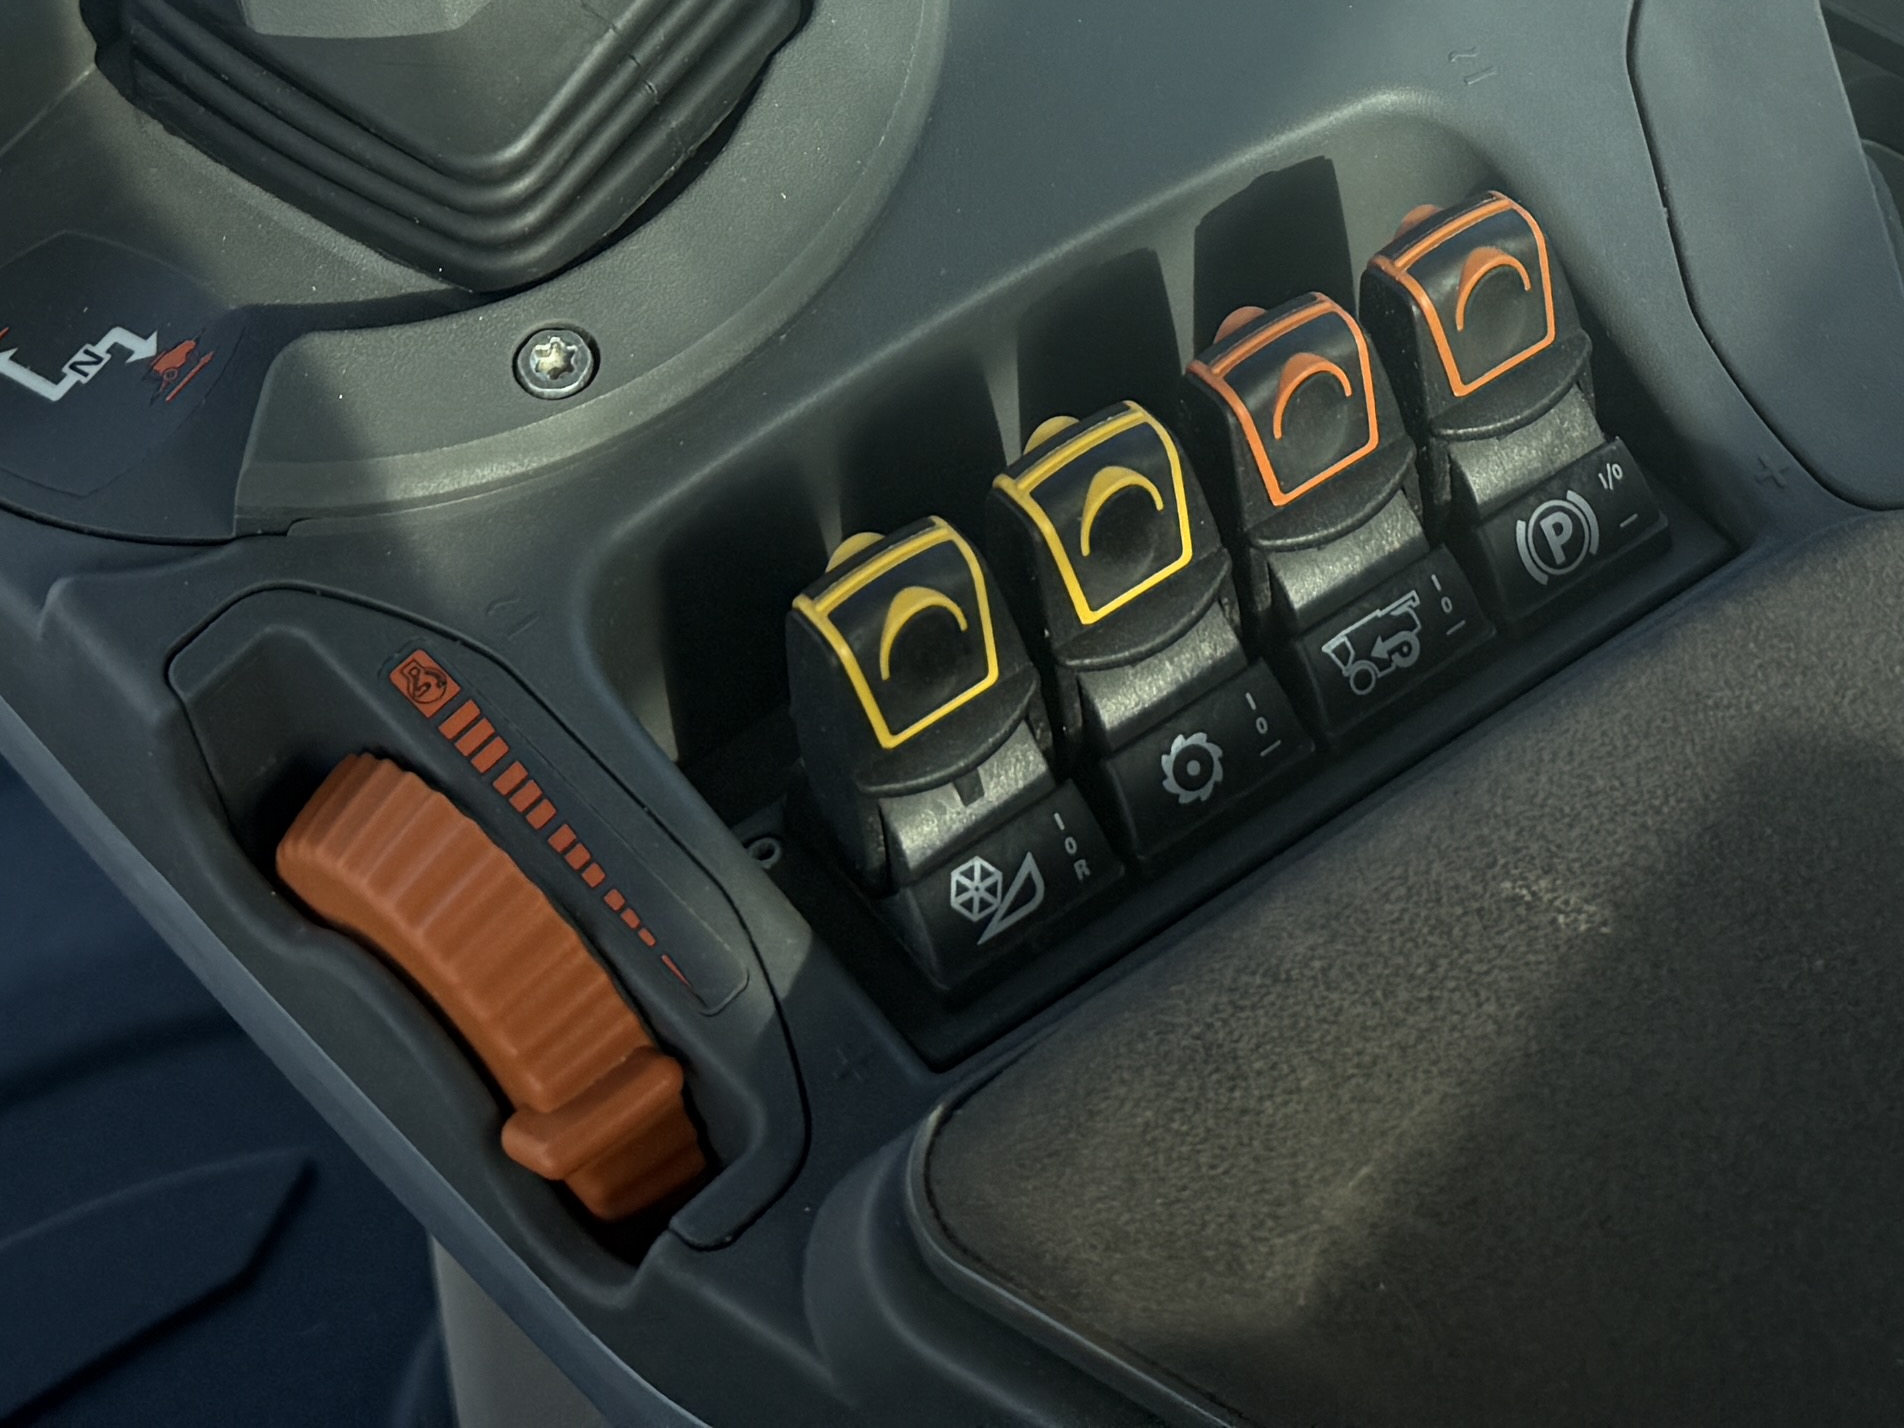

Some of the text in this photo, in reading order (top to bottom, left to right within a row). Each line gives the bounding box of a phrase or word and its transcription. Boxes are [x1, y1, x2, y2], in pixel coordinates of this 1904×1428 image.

[68, 347, 105, 378] N
[1539, 510, 1573, 565] P
[1073, 858, 1091, 881] R
